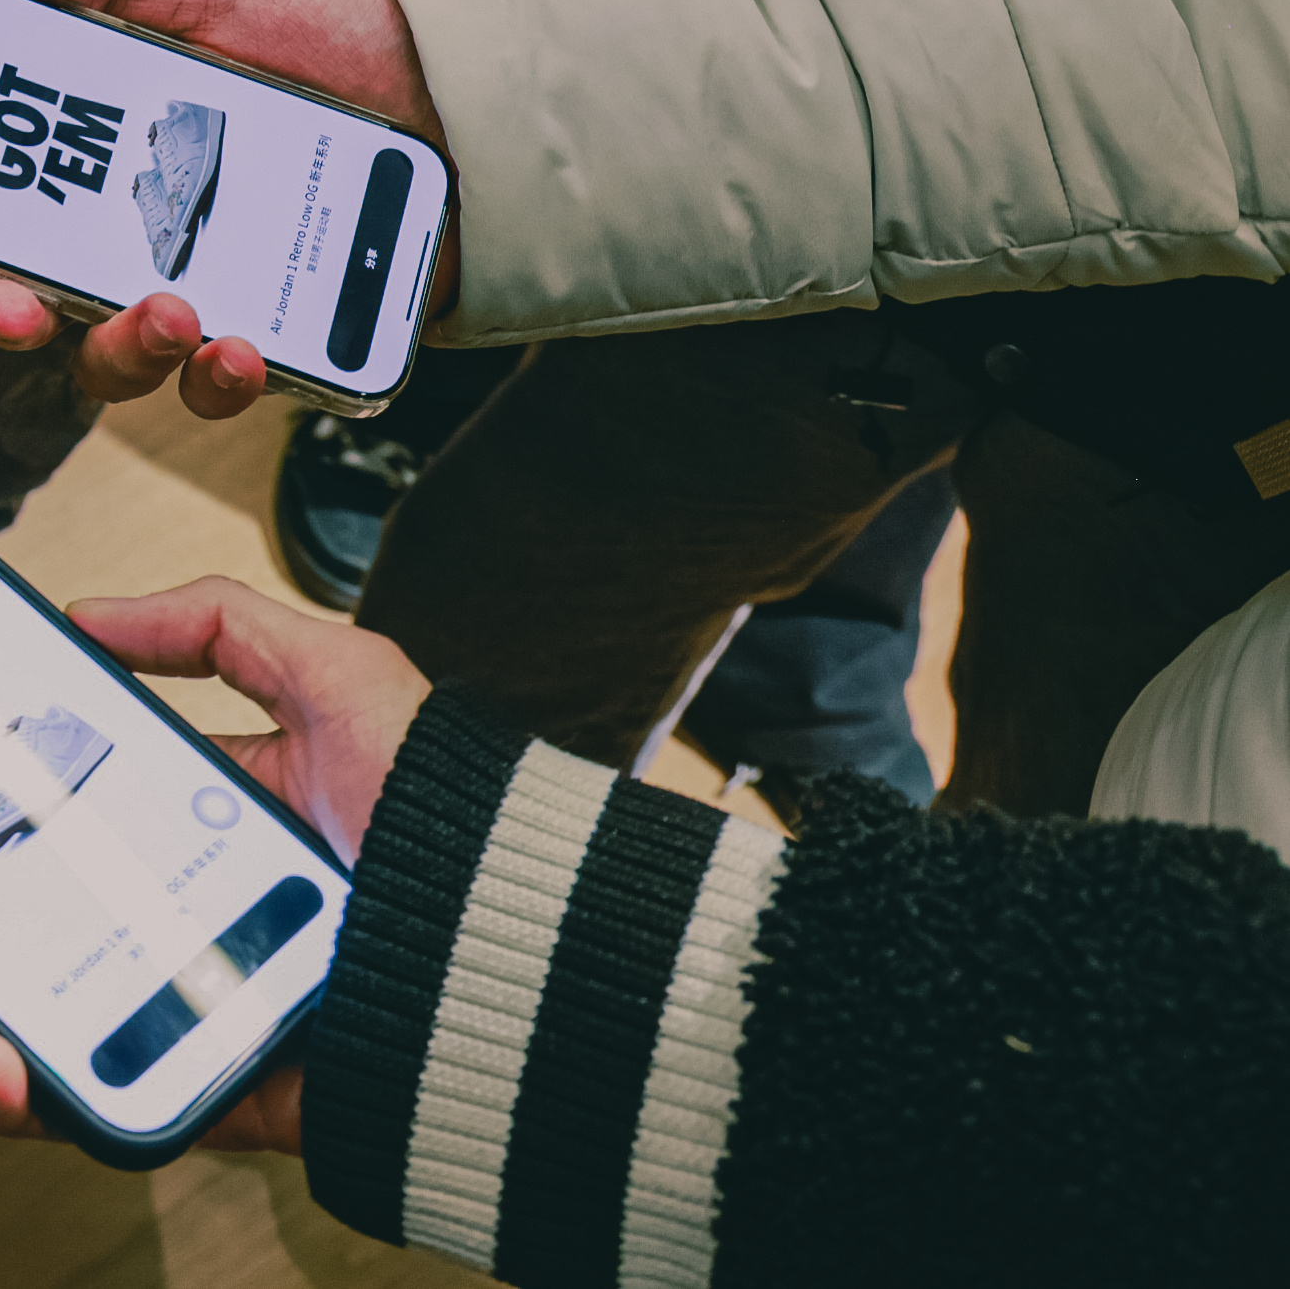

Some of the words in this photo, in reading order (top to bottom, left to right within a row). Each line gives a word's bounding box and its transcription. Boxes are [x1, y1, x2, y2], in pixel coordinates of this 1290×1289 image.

[37, 94, 124, 204] 'EM
[308, 133, 333, 183] 新年系列
[303, 182, 320, 203] OG
[296, 201, 314, 229] Low
[287, 228, 307, 262] Retro
[305, 205, 333, 274] 复刻男子运动鞋
[284, 262, 298, 272] 1
[362, 246, 380, 270] 分享
[273, 271, 296, 316] Jordan
[268, 315, 284, 335] Air
